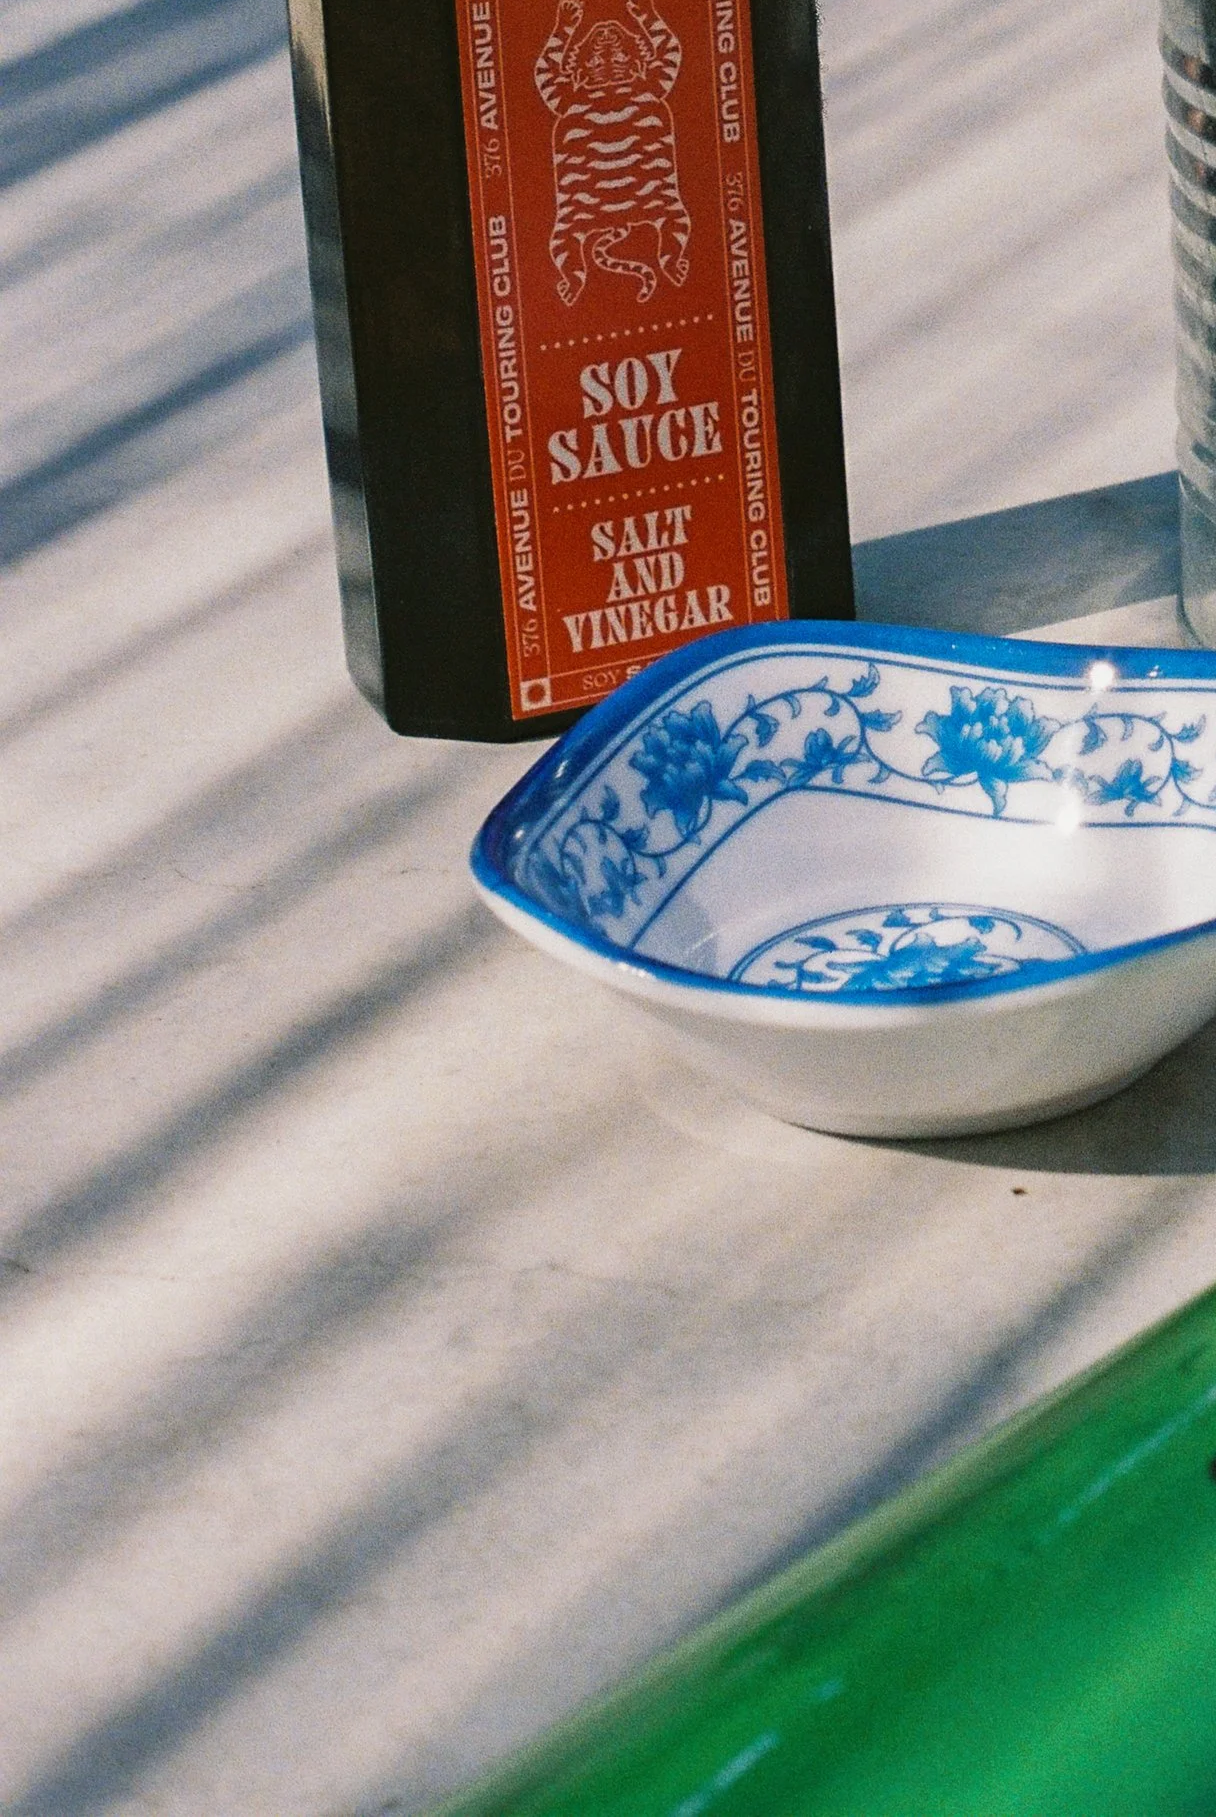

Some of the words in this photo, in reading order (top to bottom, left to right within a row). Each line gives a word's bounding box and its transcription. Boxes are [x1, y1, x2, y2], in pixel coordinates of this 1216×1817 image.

[472, 1, 499, 131] AVENUE
[719, 61, 742, 145] CLUB
[484, 137, 501, 180] 376
[724, 170, 743, 212] 376
[488, 215, 511, 296] CLUB
[727, 218, 753, 343] AVENUE
[498, 305, 524, 444] TOURING
[579, 347, 684, 419] SOY
[738, 350, 757, 383] DU
[508, 448, 526, 482] DU
[547, 401, 724, 485] SAUCE
[740, 389, 766, 523] TOURING
[508, 488, 537, 612] AVENUE
[590, 504, 693, 563] SALT
[749, 530, 774, 608] CLUB
[606, 551, 686, 603] AND
[522, 618, 541, 658] 376
[562, 584, 734, 654] VINEGAR
[582, 668, 621, 691] SOY
